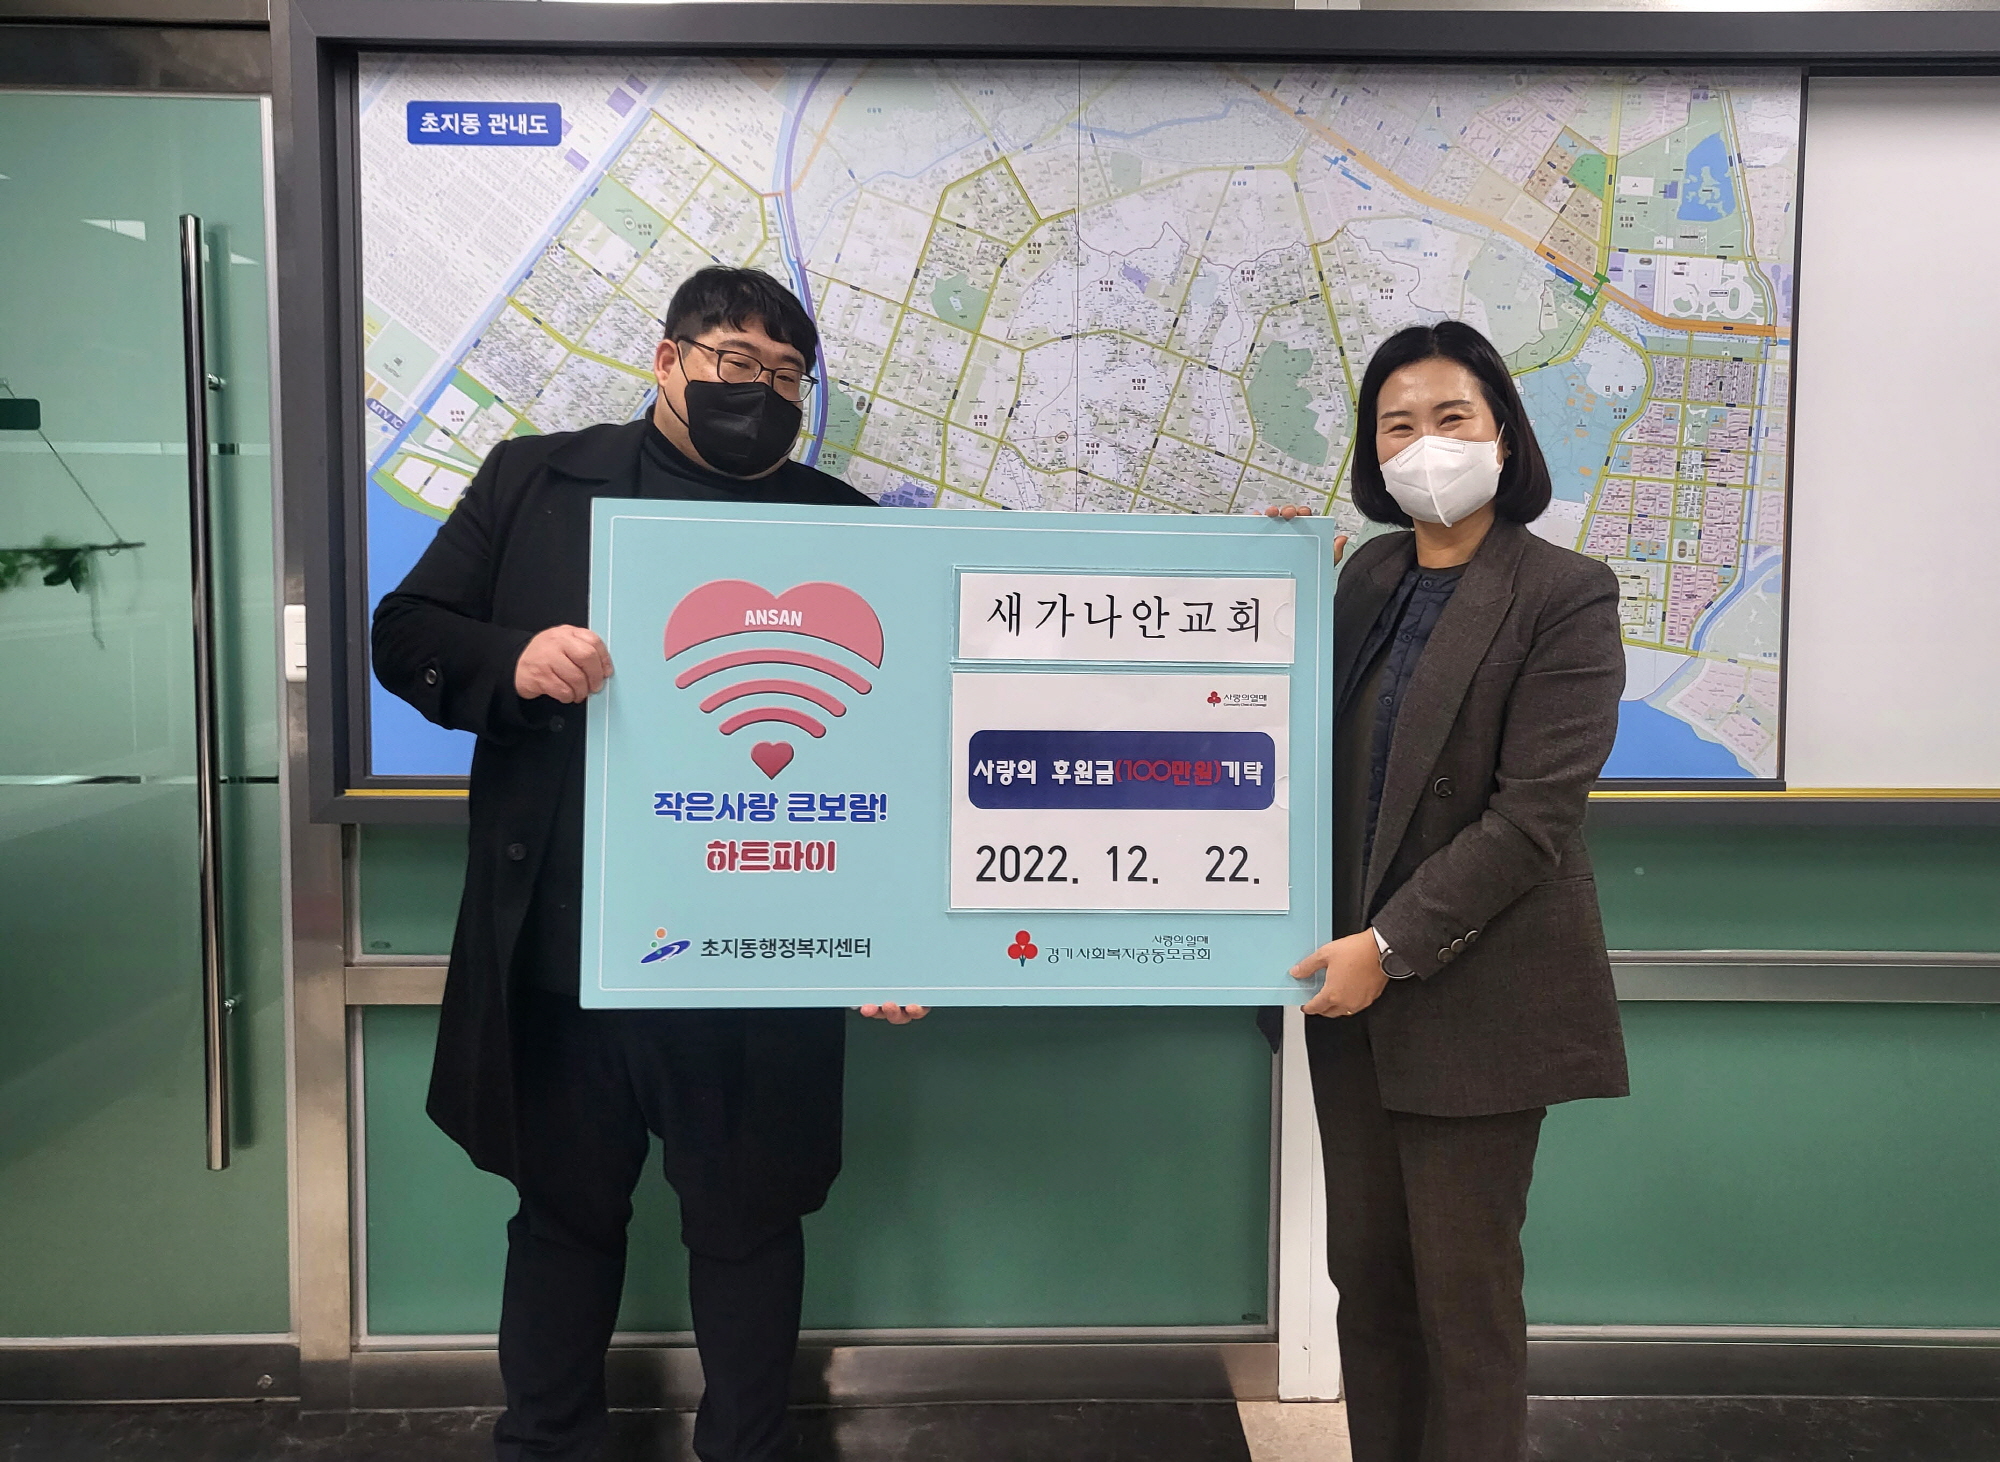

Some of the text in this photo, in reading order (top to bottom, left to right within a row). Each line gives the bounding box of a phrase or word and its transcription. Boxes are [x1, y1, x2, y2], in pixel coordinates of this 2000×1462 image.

[419, 112, 549, 136] 초지동 관내도
[744, 608, 803, 627] ANSAN
[987, 592, 1262, 643] 새가나안교회
[973, 759, 1037, 786] 사랑의
[653, 791, 888, 823] 작은사랑 큰보람!
[706, 840, 837, 873] 하트파이
[976, 845, 1261, 885] 2022. 12. 22.
[700, 937, 872, 960] 초지동행정복지센터
